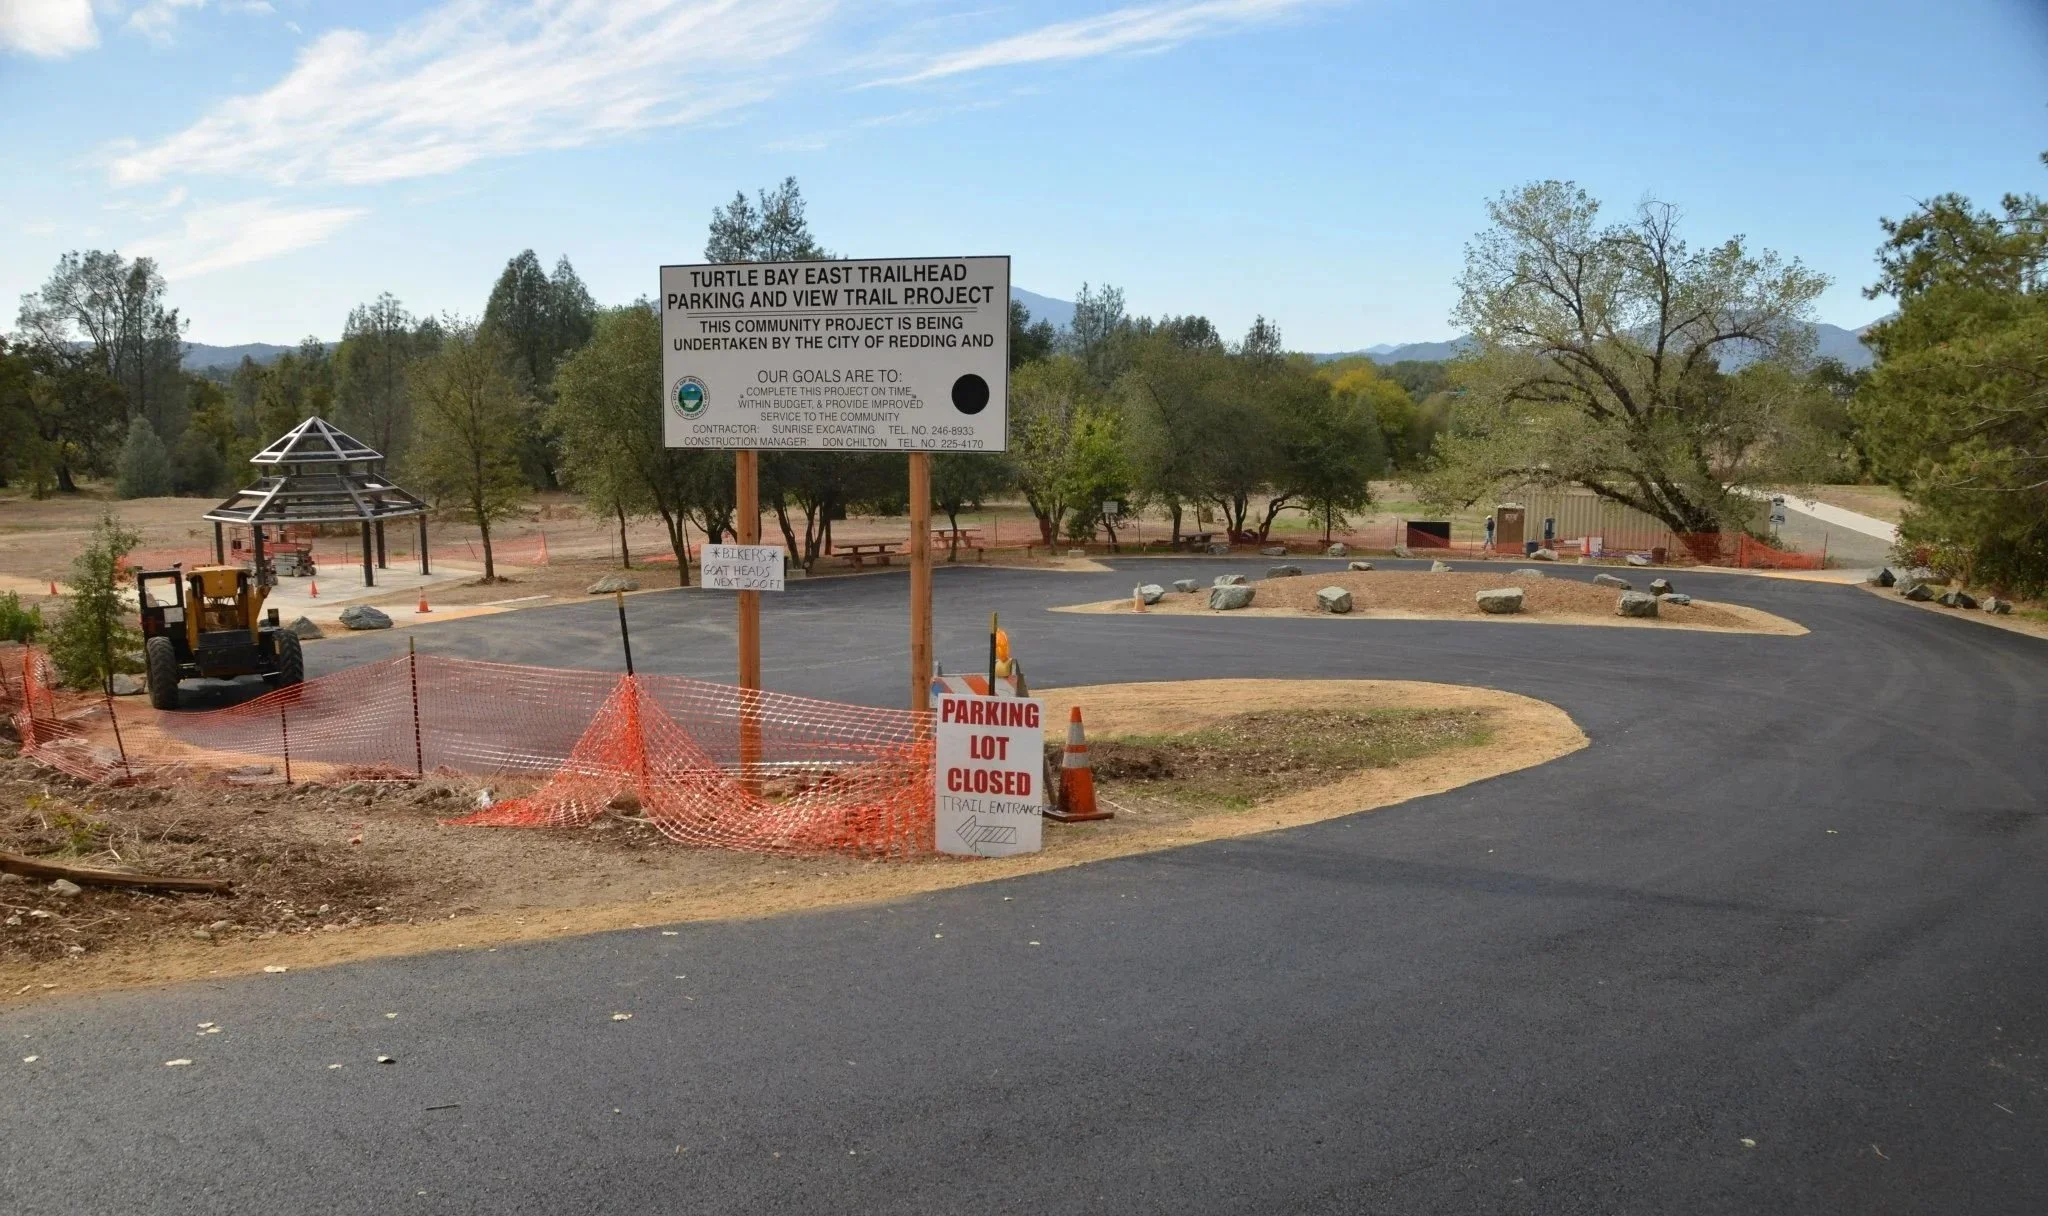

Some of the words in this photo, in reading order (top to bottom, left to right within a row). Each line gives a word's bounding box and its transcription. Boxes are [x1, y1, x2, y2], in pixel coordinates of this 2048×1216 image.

[690, 270, 759, 288] TURTLE
[764, 268, 800, 285] BAY
[805, 267, 852, 284] EAST
[858, 264, 967, 283] TRAILHEAD
[668, 292, 744, 309] PARKING
[750, 291, 787, 308] AND
[793, 290, 838, 307] VIEW
[844, 288, 897, 306] TRAIL
[904, 286, 994, 305] PROJECT
[700, 320, 731, 333] THIS
[735, 318, 821, 333] COMMUNITY
[825, 317, 893, 331] PROJECT
[898, 317, 911, 330] IS
[916, 316, 963, 330] BEING
[674, 337, 768, 350] UNDERTAKEN
[772, 337, 790, 349] BY
[794, 336, 823, 349] THE
[827, 335, 860, 348] CITY
[864, 335, 884, 348] OF
[889, 334, 957, 348] REDDING
[961, 334, 994, 347] AND
[757, 370, 788, 383] OUR
[793, 370, 841, 383] GOALS
[845, 369, 874, 383] ARE
[878, 369, 902, 383] TO:
[746, 387, 797, 396] COMPLETE
[801, 387, 822, 396] THIS
[824, 386, 869, 396] PROJECT
[871, 387, 886, 396] ON
[738, 400, 771, 408] WITHIN
[773, 400, 814, 409] BUDGET,
[817, 400, 823, 408] &
[825, 399, 869, 409] PROVIDE
[871, 400, 924, 409] IMPROVED
[761, 412, 801, 421] SERVICE
[804, 413, 817, 421] TO
[819, 412, 838, 422] THE
[840, 413, 900, 422] COMMUNITY
[692, 425, 760, 434] CONTRACTOR:
[772, 425, 813, 434] SUNRISE
[816, 425, 875, 435] EXCAVATING
[889, 426, 909, 435] TEL.
[932, 427, 974, 435] 246-8933
[684, 437, 757, 446] CONSTRUCTION
[759, 437, 809, 446] MANAGER:
[822, 437, 843, 447] DON
[845, 438, 888, 447] CHILTON
[898, 439, 918, 448] TEL.
[941, 440, 983, 448] 225-4170
[704, 564, 730, 575] GOAT
[734, 566, 771, 577] HEADS
[714, 578, 740, 587] NEXT
[942, 699, 1039, 728] PARKING
[970, 735, 1009, 760] LOT
[947, 768, 1031, 796] CLOSED
[940, 795, 988, 813] TRAIL
[990, 801, 1042, 816] ENTRANCE
